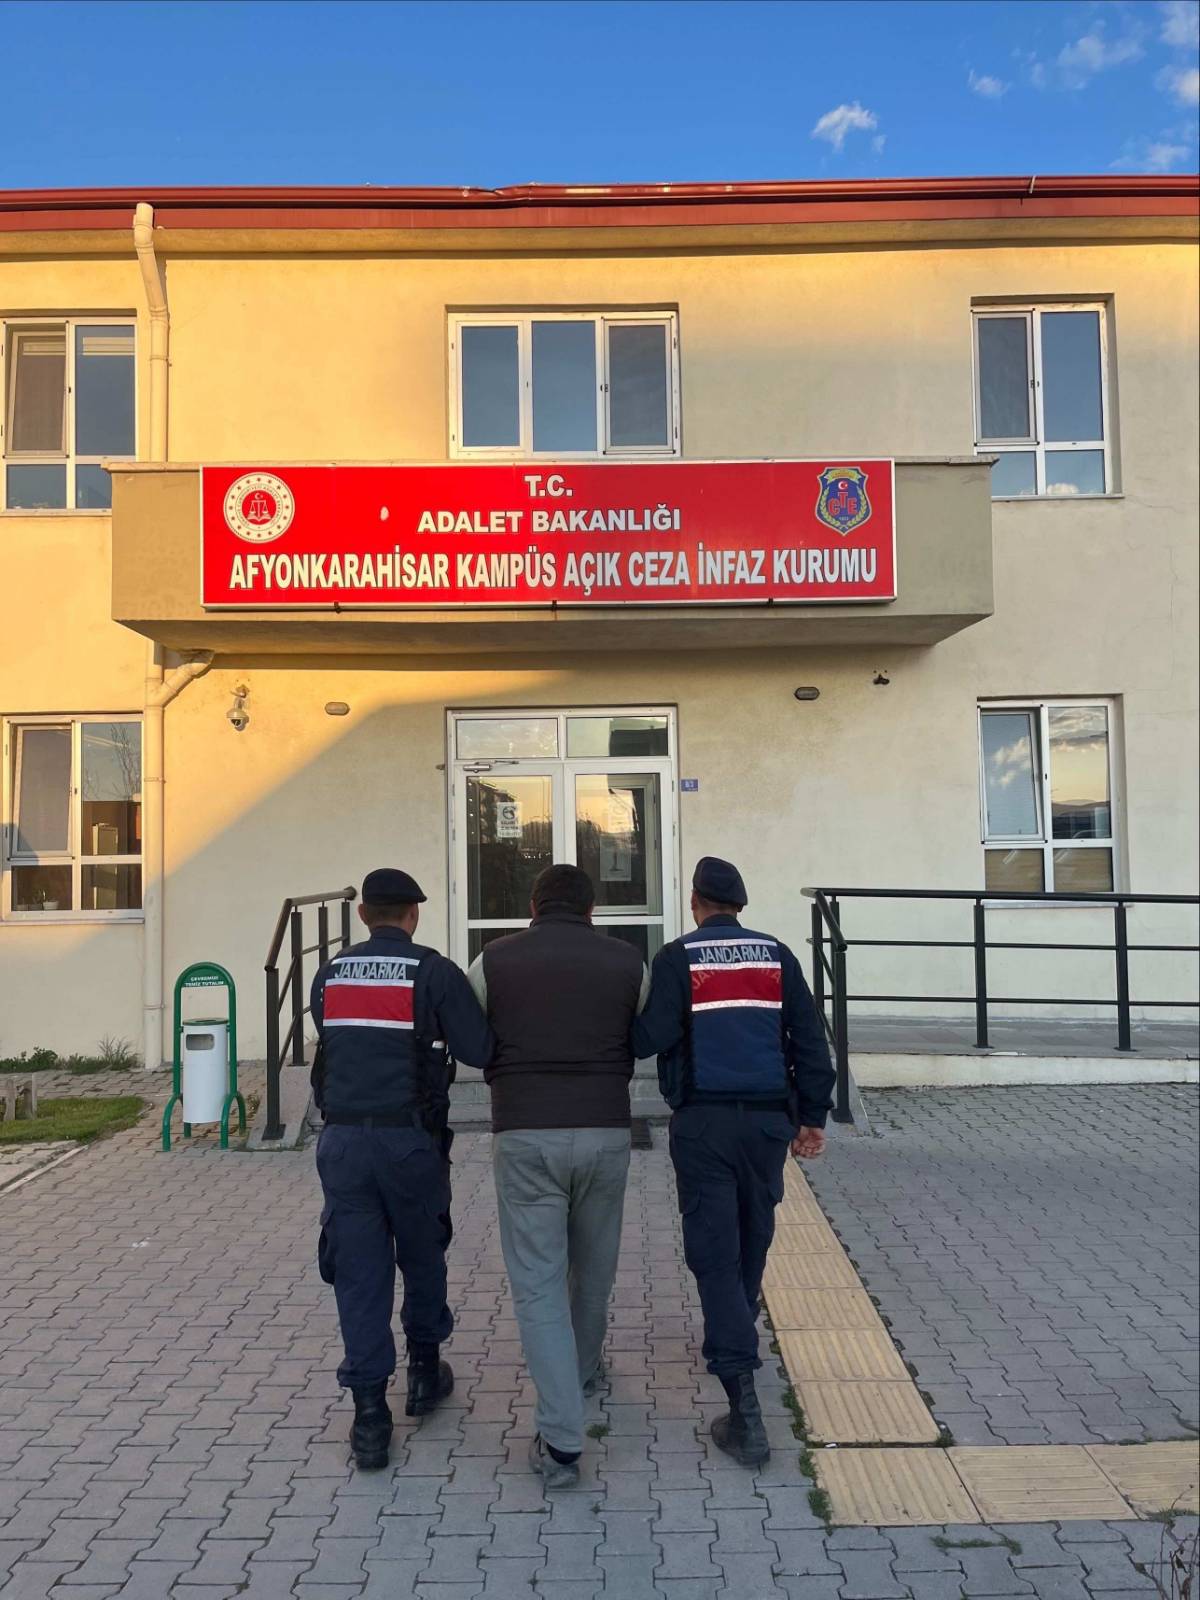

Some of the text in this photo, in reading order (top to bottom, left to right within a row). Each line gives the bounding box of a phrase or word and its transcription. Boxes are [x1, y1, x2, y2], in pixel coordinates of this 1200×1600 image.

[525, 475, 573, 496] T.C.
[417, 504, 680, 532] ADALET BAKANLIĞI
[229, 542, 877, 595] AFYONKARAHİSAR KAMPÜS AÇIK CEZA İNFAZ KURUMU
[699, 945, 772, 963] JANDARMA
[334, 963, 406, 979] JANDARMA
